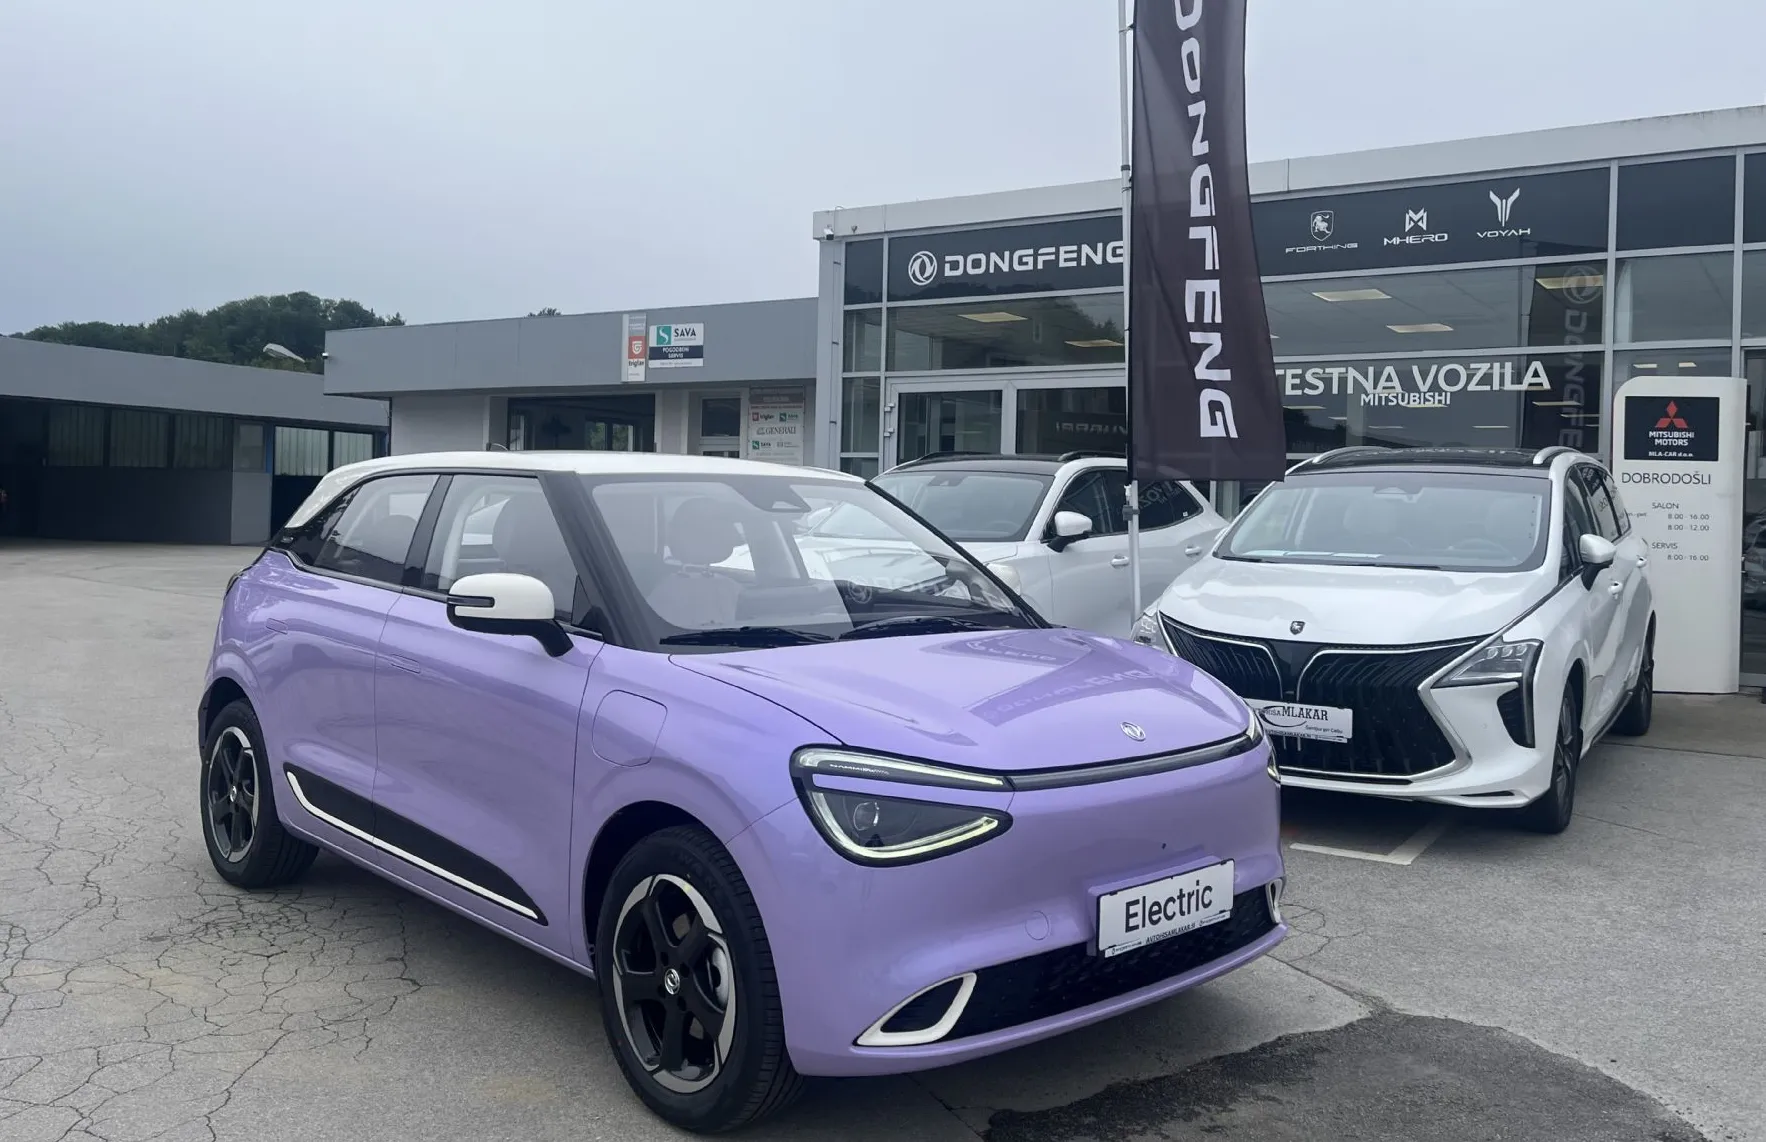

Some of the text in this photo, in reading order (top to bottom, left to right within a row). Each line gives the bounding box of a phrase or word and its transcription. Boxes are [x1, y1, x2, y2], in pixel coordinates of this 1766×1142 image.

[1383, 232, 1448, 246] MHERO
[1476, 227, 1531, 239] VOYAH
[1285, 242, 1359, 254] FORTHING
[944, 240, 1124, 277] DONGFENG
[674, 327, 697, 338] SAVA
[1411, 360, 1552, 394] VOZILA
[1360, 390, 1451, 407] MITSUBISHI
[765, 426, 797, 435] GENERALI
[1648, 431, 1695, 439] MITSUBISHI
[1654, 438, 1689, 446] MOTORS
[1621, 470, 1711, 485] DOBRODOŠLI
[1651, 542, 1678, 550] SERVIS
[1282, 706, 1329, 721] MLAKAR
[1125, 879, 1213, 933] Electric
